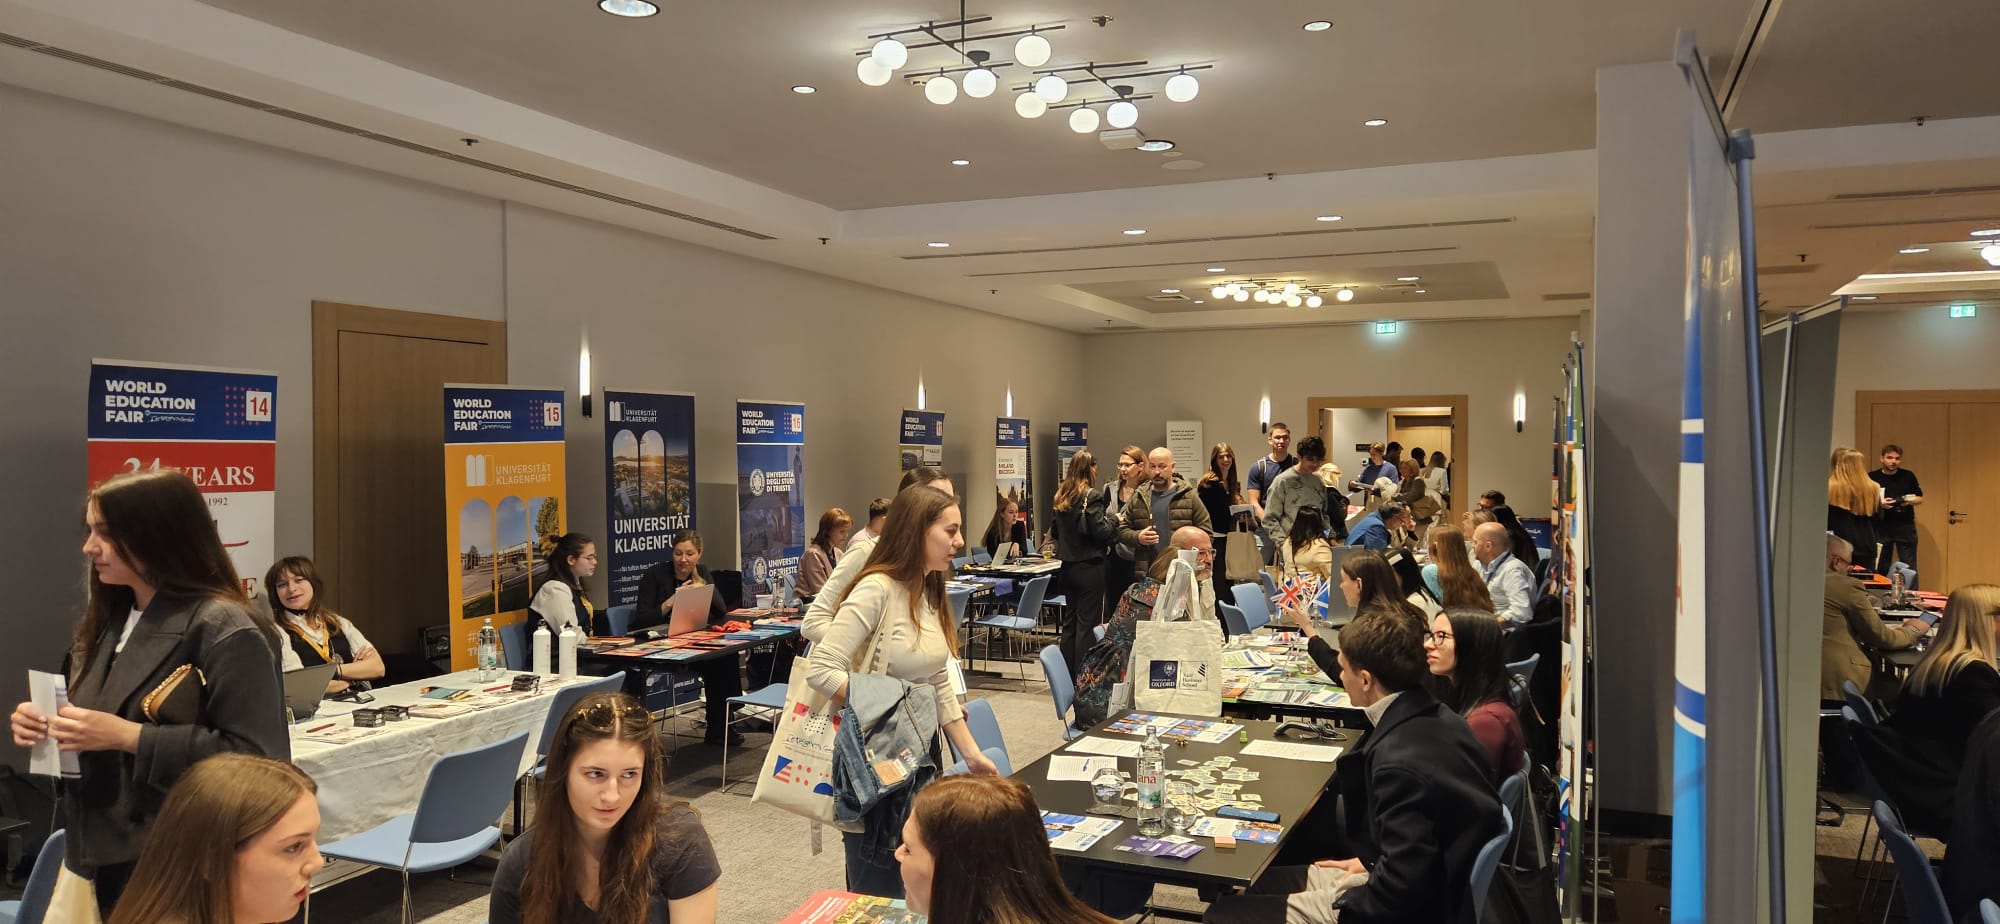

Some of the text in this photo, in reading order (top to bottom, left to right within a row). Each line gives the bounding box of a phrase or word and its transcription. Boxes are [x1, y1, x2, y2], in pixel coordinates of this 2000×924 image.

[105, 379, 167, 394] WORLD
[105, 395, 196, 410] EDUCATION
[250, 396, 268, 415] 14
[453, 398, 492, 408] WORLD
[105, 410, 144, 423] FAIR
[453, 410, 512, 419] EDUCATION
[546, 407, 559, 422] 15
[742, 410, 764, 418] WORLD
[454, 421, 478, 431] FAIR
[793, 417, 801, 429] 16
[496, 463, 551, 475] UNIVERSITÄT
[495, 473, 552, 485] KLAGENFURT
[773, 484, 792, 492] TRIESTE
[208, 497, 228, 506] 1992
[614, 512, 690, 534] UNIVERSITÄT
[615, 534, 677, 554] KLAGENFU
[768, 556, 800, 568] UNIVERSITY
[768, 566, 798, 577] OF TRIESTE
